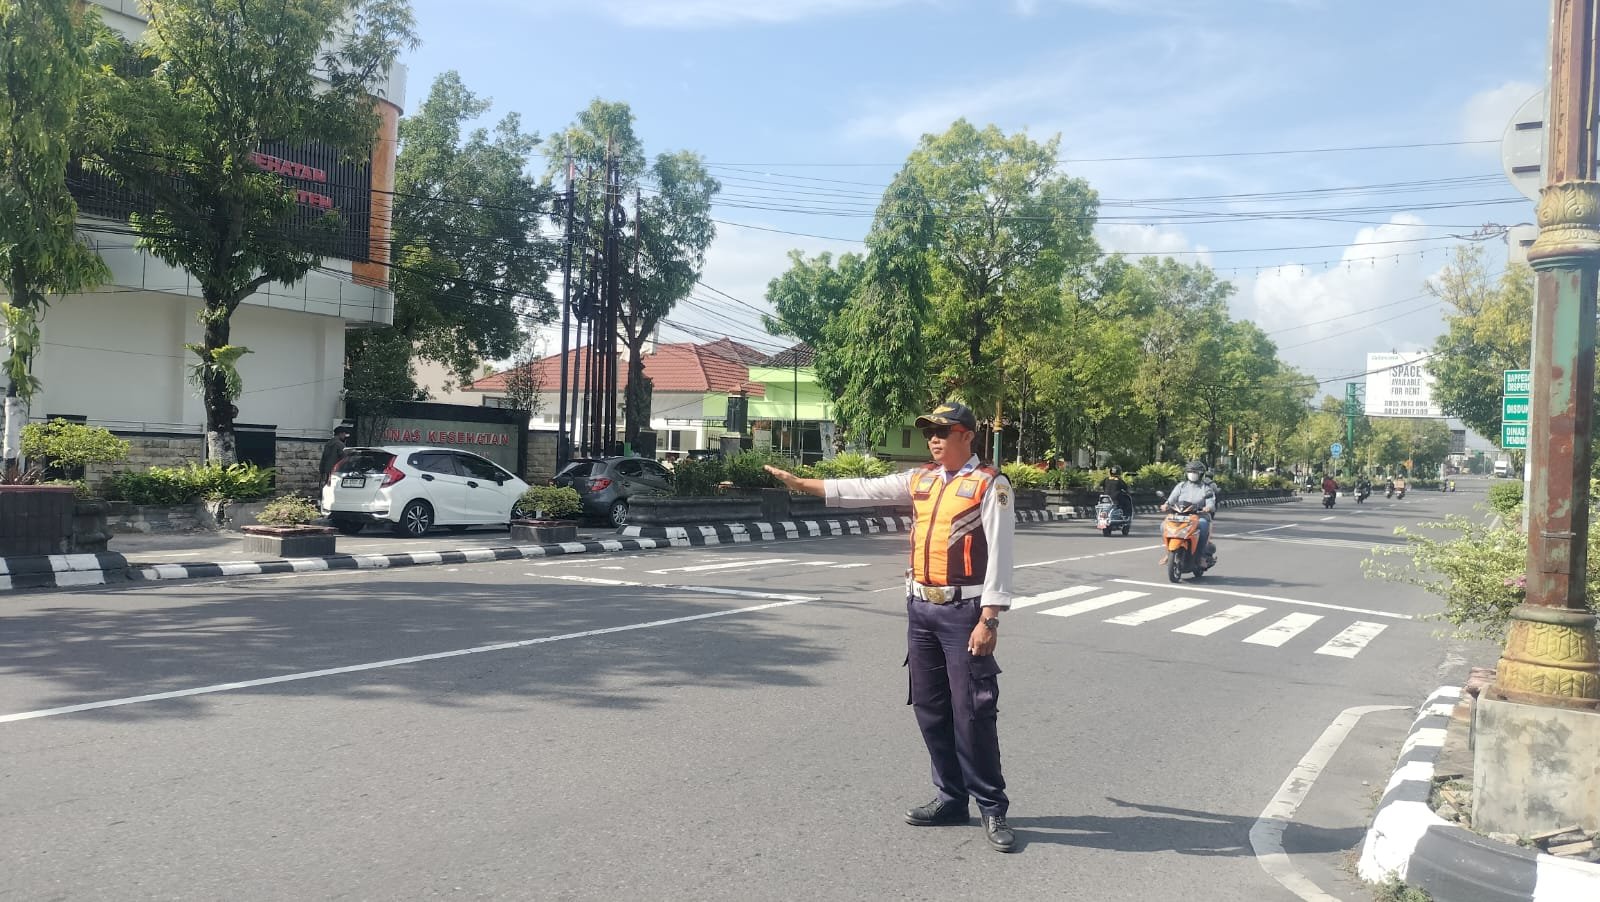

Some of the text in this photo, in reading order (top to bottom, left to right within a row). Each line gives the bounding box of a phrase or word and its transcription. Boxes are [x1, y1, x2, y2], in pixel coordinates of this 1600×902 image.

[250, 152, 327, 183] EHATAN
[296, 189, 333, 209] TEN
[1392, 366, 1421, 377] SPACE
[1391, 387, 1421, 395] FOR RENT
[383, 427, 509, 445] INAS KESEHATAN
[1506, 427, 1526, 436] DINAS
